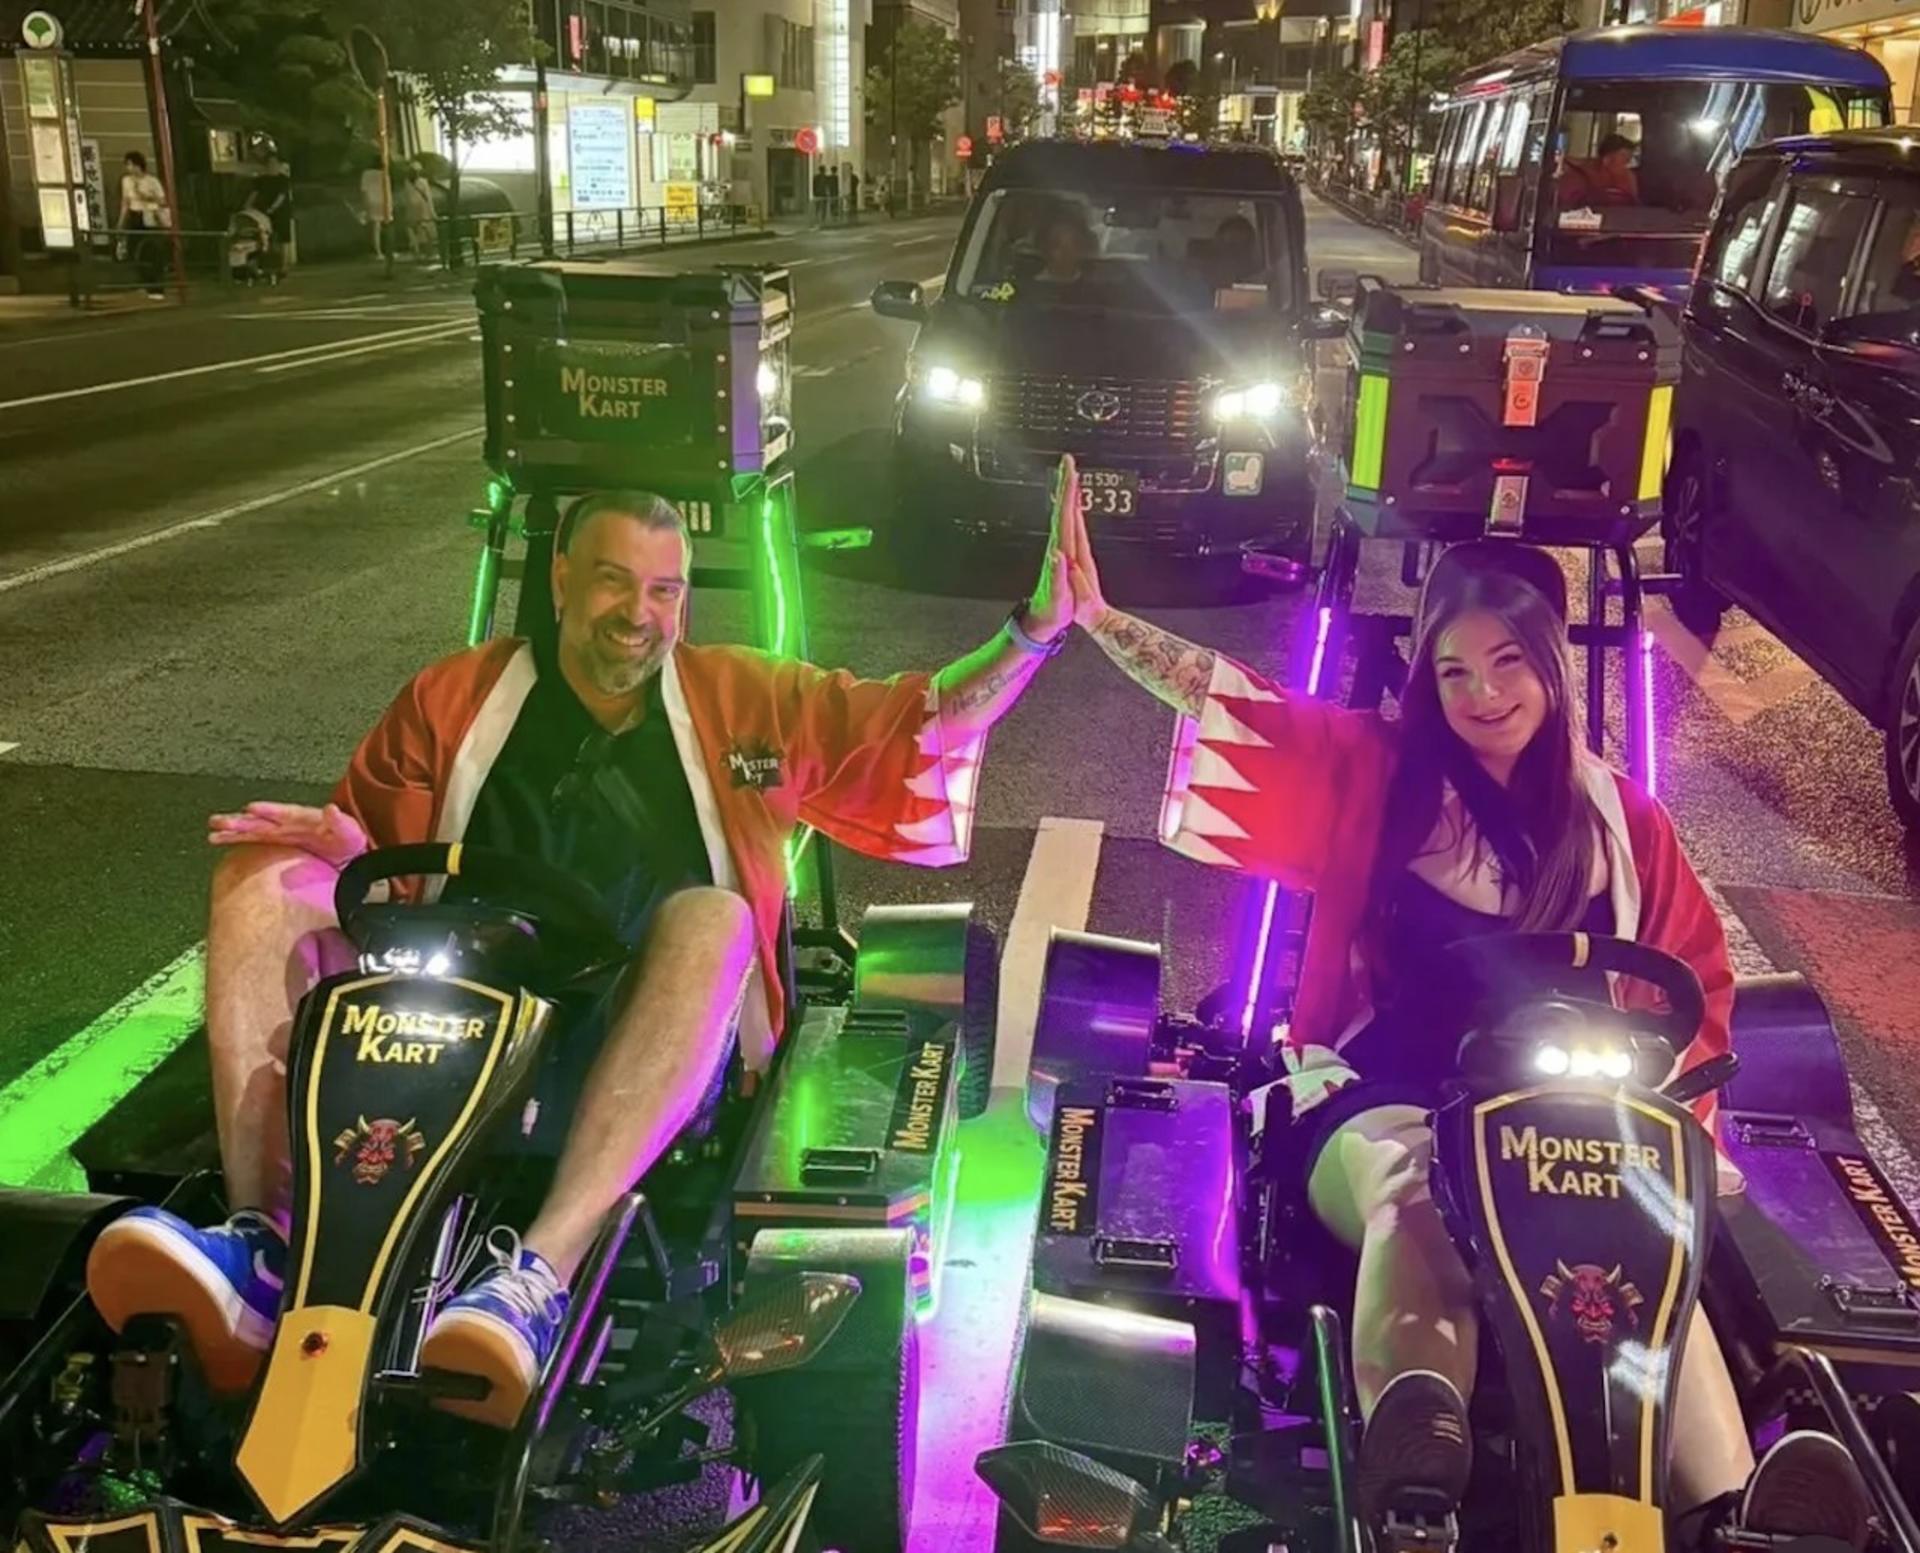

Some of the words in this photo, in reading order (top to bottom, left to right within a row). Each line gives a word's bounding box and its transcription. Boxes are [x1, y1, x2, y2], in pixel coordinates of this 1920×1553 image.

[561, 366, 668, 396] MONSTER
[580, 393, 641, 418] KART
[1081, 488, 1132, 513] 3-33
[341, 1004, 486, 1041] MONSTER
[356, 1034, 445, 1064] KART
[910, 1041, 945, 1081] KART
[893, 1077, 938, 1149] MONSTER
[1057, 1108, 1095, 1180] MONSTER
[1501, 1125, 1661, 1170] MONSTER
[1530, 1160, 1622, 1199] KART
[1836, 1156, 1890, 1203] KART
[1051, 1181, 1088, 1230] KART
